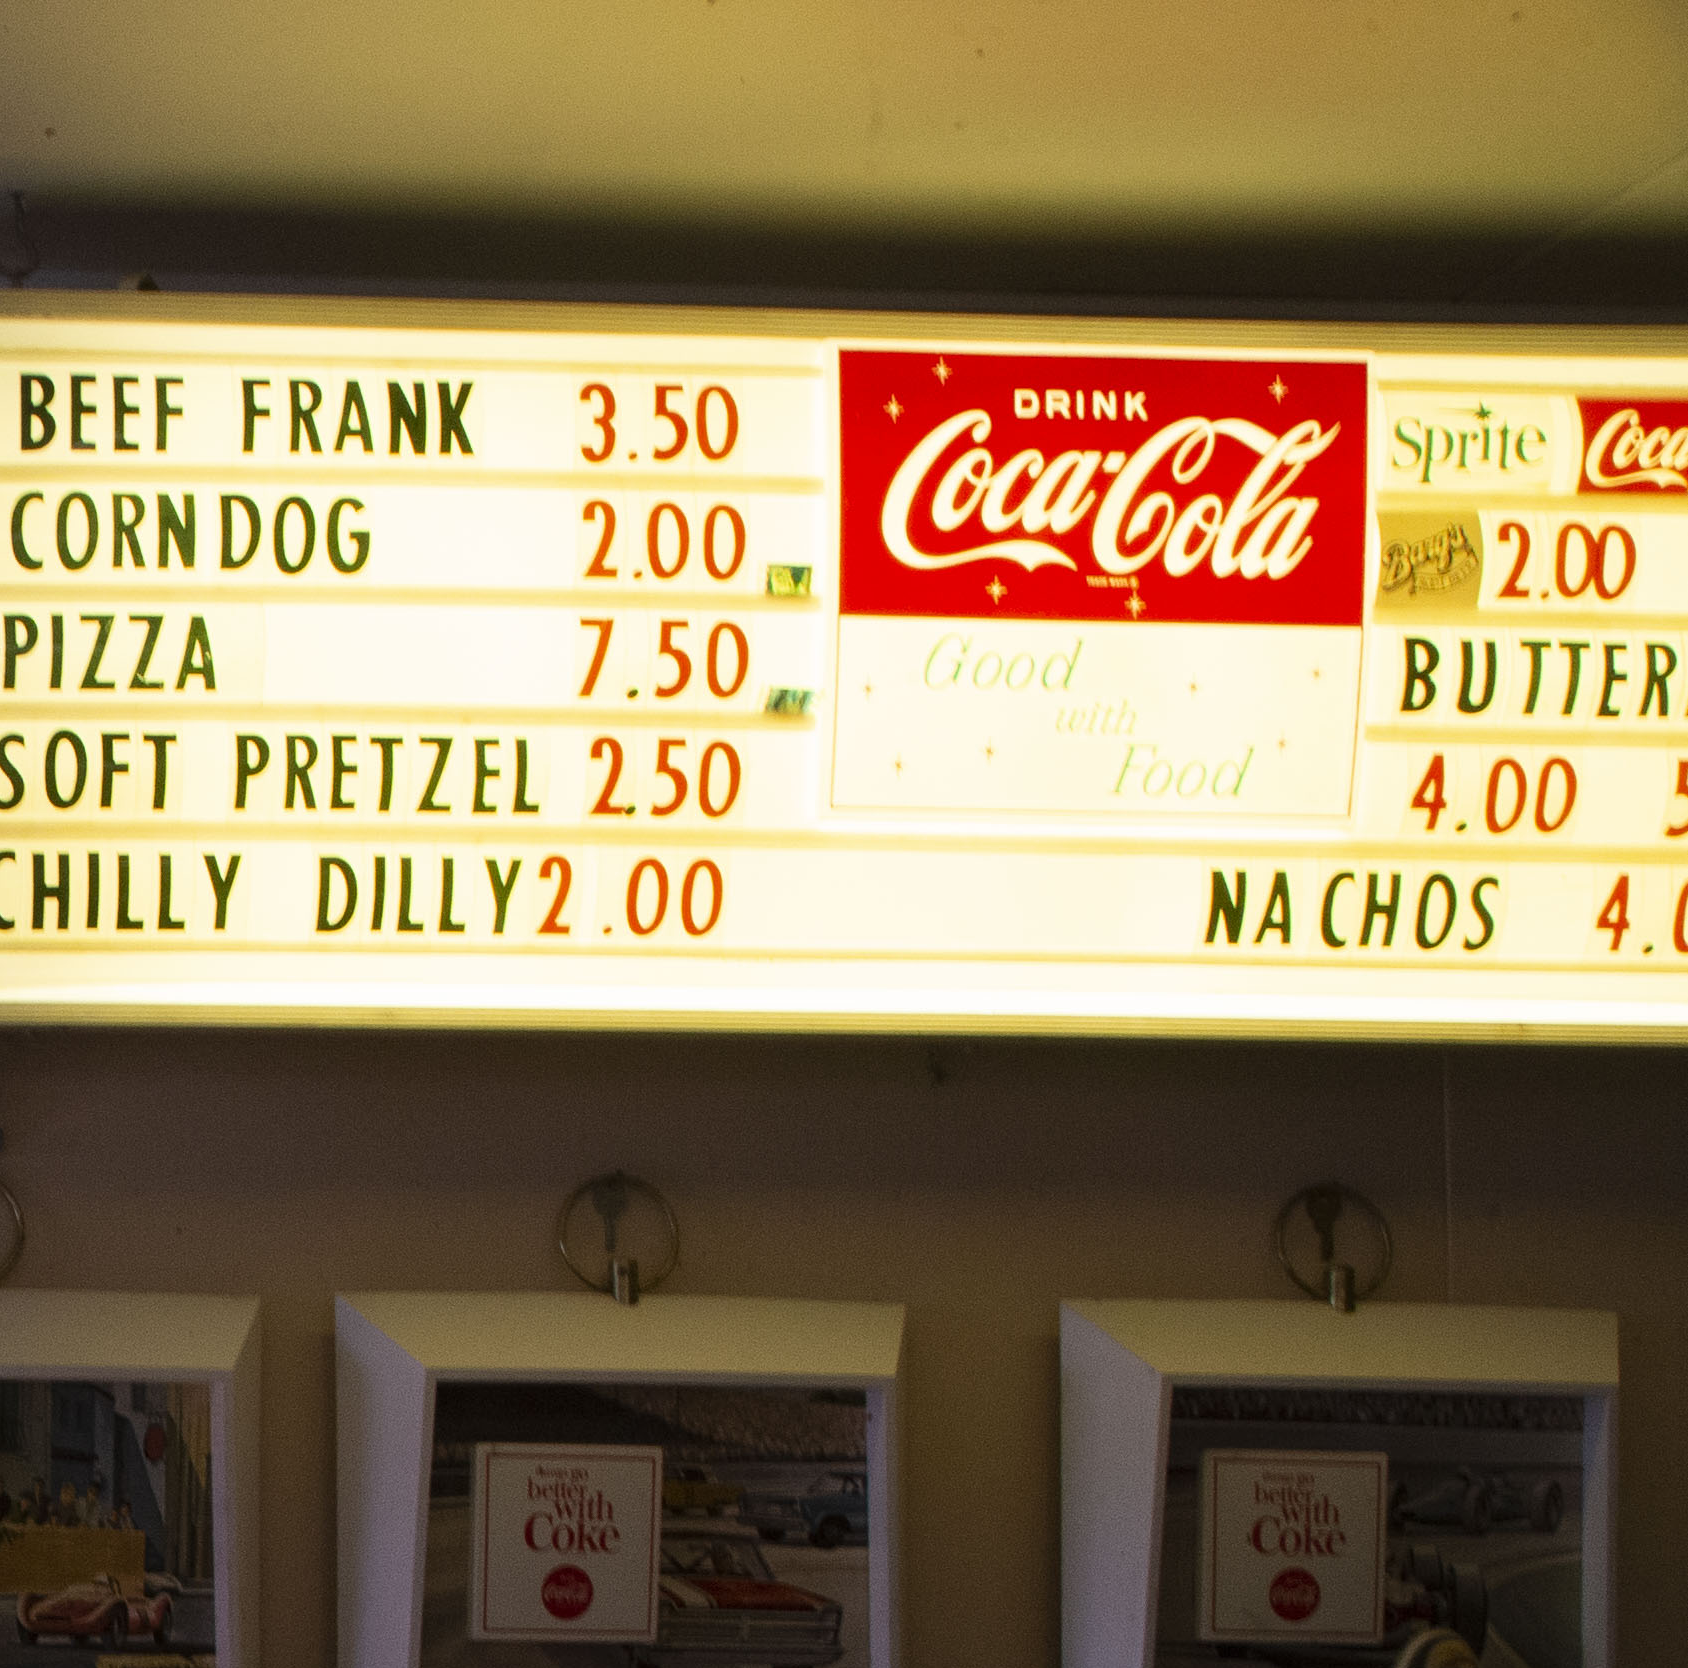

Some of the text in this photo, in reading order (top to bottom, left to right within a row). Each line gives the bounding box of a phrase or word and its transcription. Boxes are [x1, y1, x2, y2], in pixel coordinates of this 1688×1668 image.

[18, 372, 739, 465] BEEF FRANK 3.50
[1013, 388, 1148, 421] DRINK
[1392, 402, 1548, 484] Sprite
[881, 407, 1343, 581] Coca-Cola
[582, 500, 747, 582] 2.00
[1497, 521, 1636, 601] 2.00
[2, 613, 750, 701] PIZZA 7.50
[923, 634, 1083, 692] Good
[1401, 637, 1678, 719] BUTTER
[1055, 699, 1138, 737] with
[233, 733, 540, 816] PRETZEL
[589, 736, 742, 820] 2.50
[1110, 744, 1254, 800] Food
[1411, 753, 1578, 835] 4.00
[315, 855, 523, 935] DILLY
[537, 855, 725, 937] 2.00
[1204, 868, 1500, 951] NACHOS
[527, 1475, 587, 1500] better
[553, 1490, 614, 1521] with
[1281, 1493, 1340, 1526] with
[524, 1511, 620, 1554] Coke
[1251, 1514, 1346, 1558] Coke
